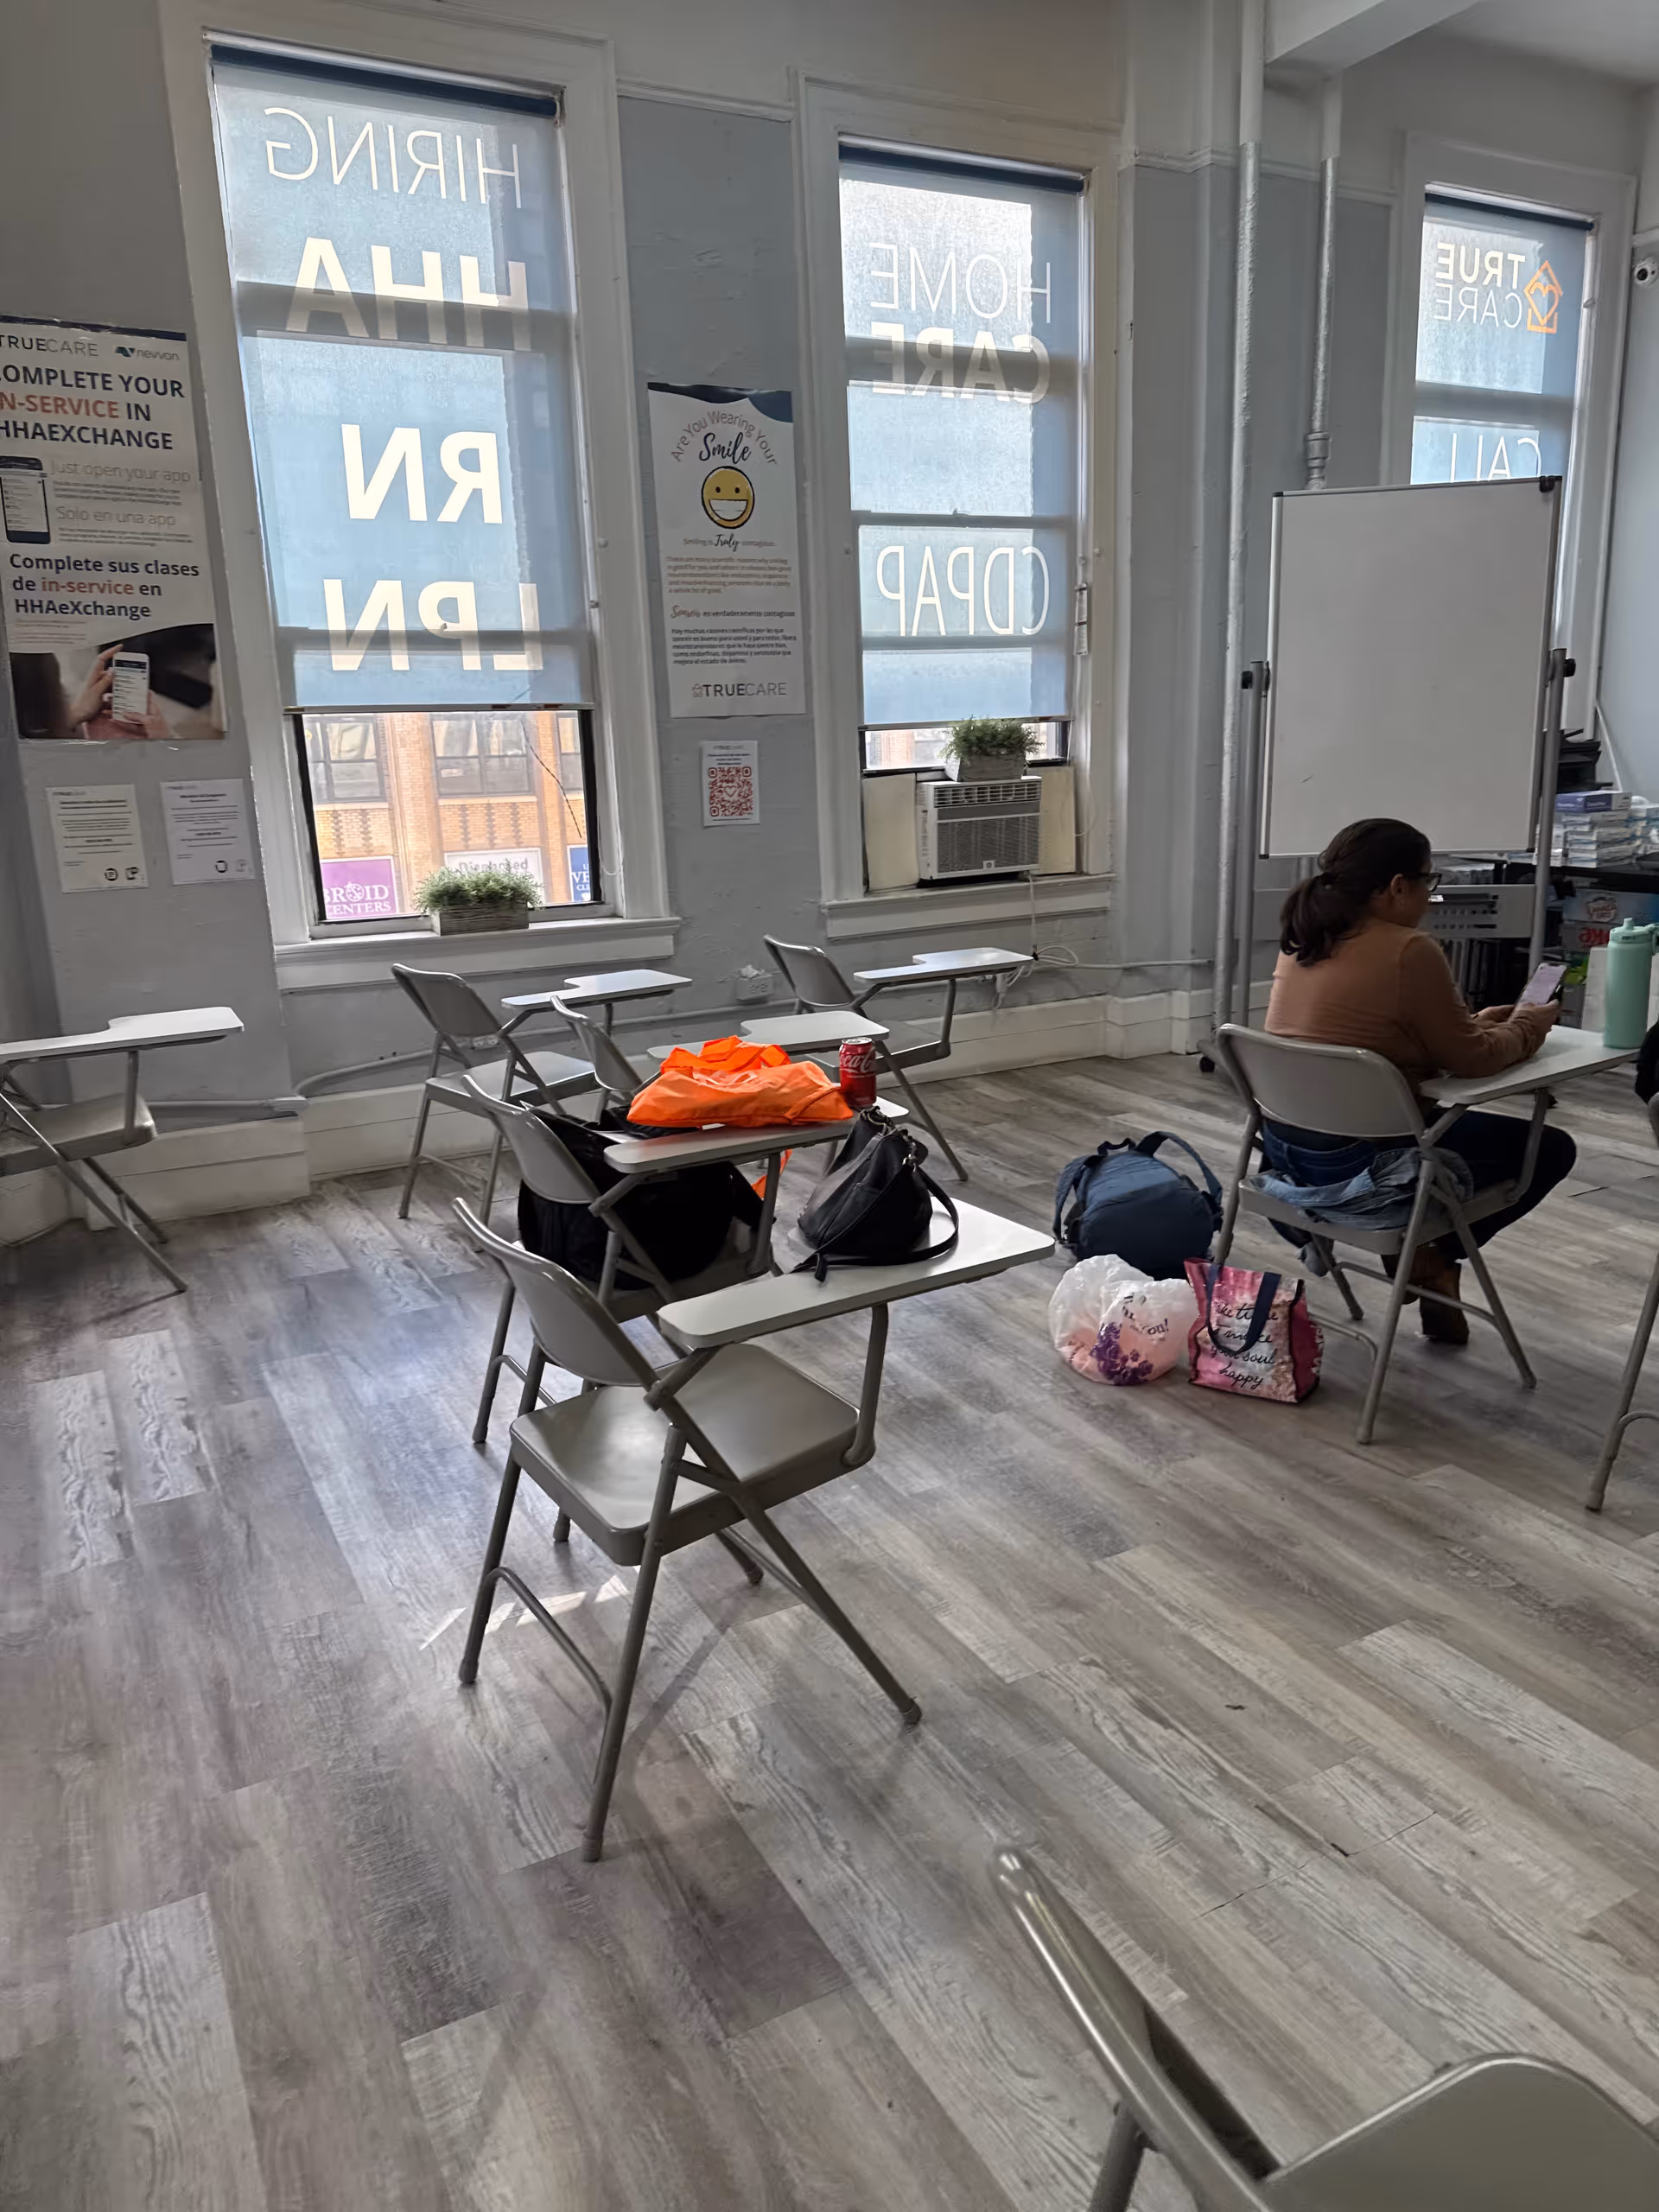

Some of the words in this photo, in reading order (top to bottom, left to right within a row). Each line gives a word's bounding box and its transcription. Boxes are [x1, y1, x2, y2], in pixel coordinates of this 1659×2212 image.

[0, 364, 113, 391] OMPLETE
[118, 374, 186, 398] YOUR
[0, 391, 120, 419] N-SERVICE
[126, 403, 151, 422] IN
[671, 435, 690, 462] Are
[683, 416, 708, 437] You
[707, 410, 756, 438] Wearing
[755, 429, 777, 466] Your
[699, 432, 751, 464] Smile
[49, 459, 80, 475] Just
[84, 464, 121, 478] open
[124, 467, 162, 481] your
[163, 471, 191, 483] app
[55, 505, 90, 521] Solo
[93, 510, 112, 522] en
[118, 512, 143, 524] una
[149, 514, 176, 526] app
[714, 533, 740, 552] Truly
[10, 553, 104, 574] Complete
[109, 560, 139, 574] sus
[144, 560, 200, 576] clases
[12, 576, 35, 591] de
[41, 577, 135, 595] in-service
[139, 584, 162, 596] en
[15, 598, 151, 621] HHAeXchange
[703, 682, 787, 697] TRUECARE
[1243, 1349, 1275, 1364] soul
[1218, 1362, 1264, 1390] happy
